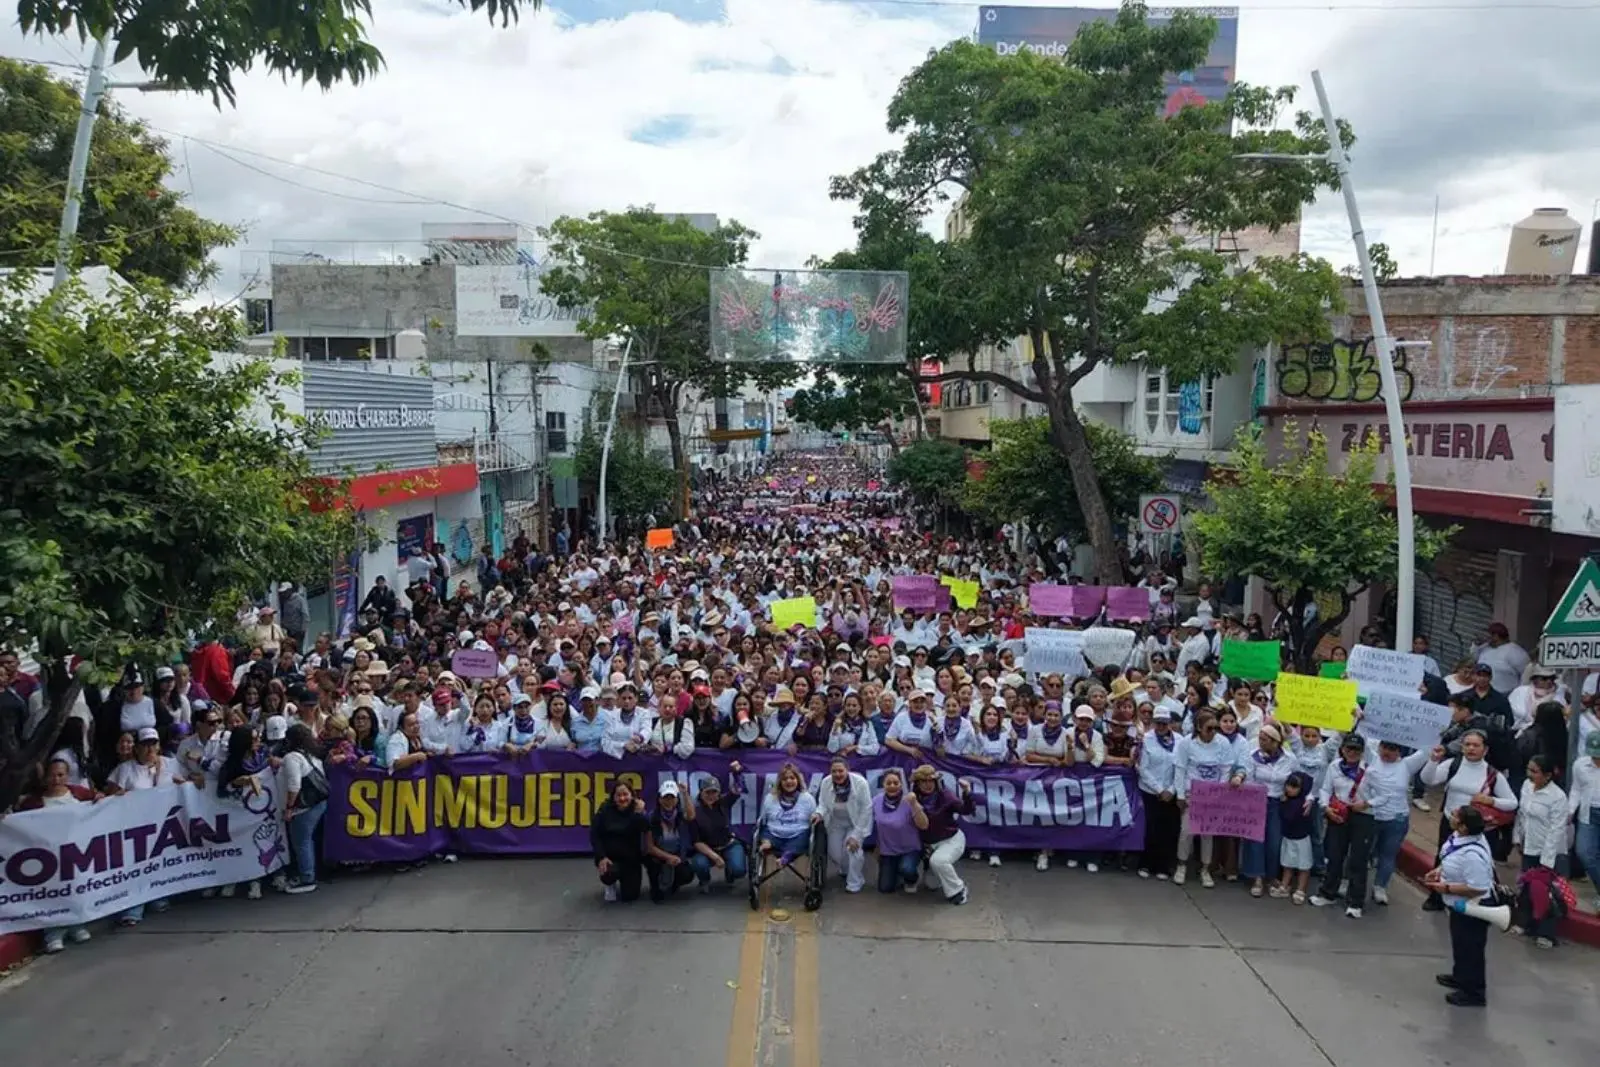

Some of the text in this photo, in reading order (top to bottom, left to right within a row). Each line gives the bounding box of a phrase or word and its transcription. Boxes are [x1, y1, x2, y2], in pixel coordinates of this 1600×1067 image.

[357, 403, 399, 428] CHARLES
[345, 776, 428, 838] SIN
[866, 767, 1135, 828] CRACIA
[0, 805, 232, 887] OMITÁN
[76, 869, 141, 894] efectiva
[143, 861, 160, 875] de
[163, 856, 183, 868] las
[185, 847, 243, 862] mujeres
